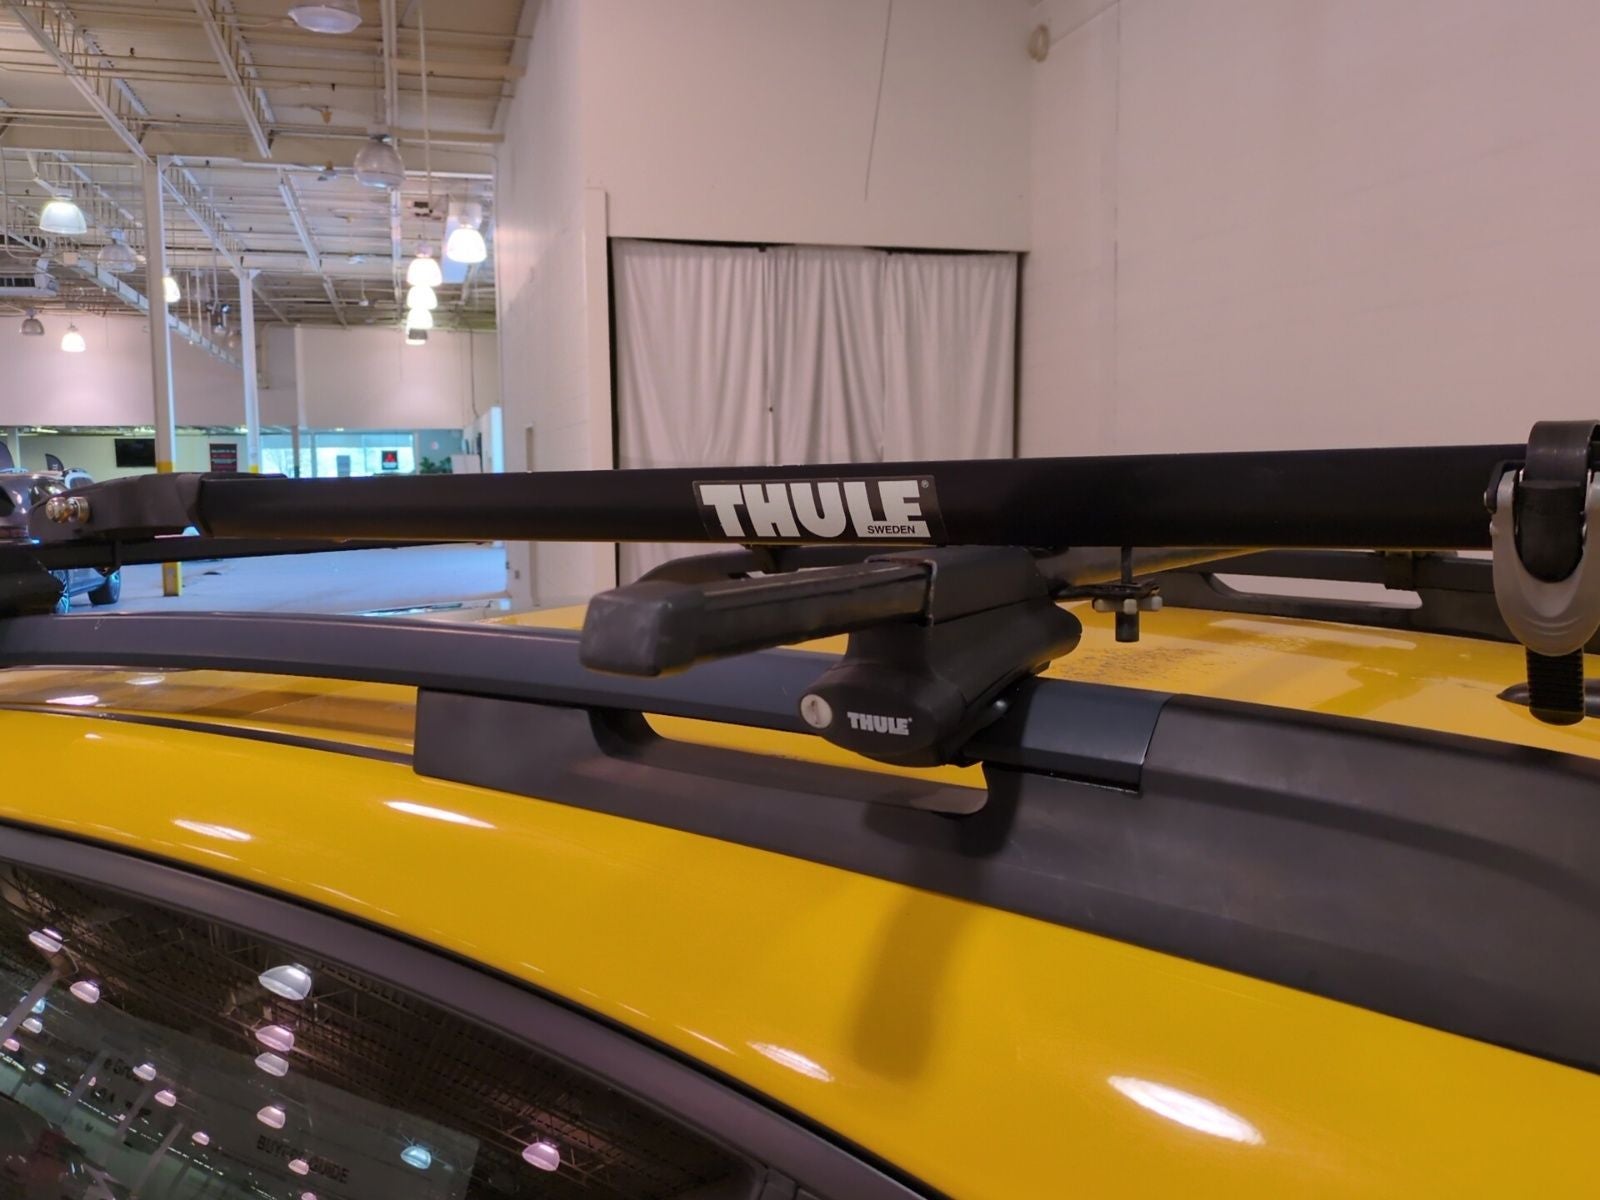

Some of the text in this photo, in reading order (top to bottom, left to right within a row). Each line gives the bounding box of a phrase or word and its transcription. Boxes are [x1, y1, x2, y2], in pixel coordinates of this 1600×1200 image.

[699, 479, 932, 538] THULE
[867, 524, 916, 535] SWEDEN
[846, 711, 910, 736] THULE
